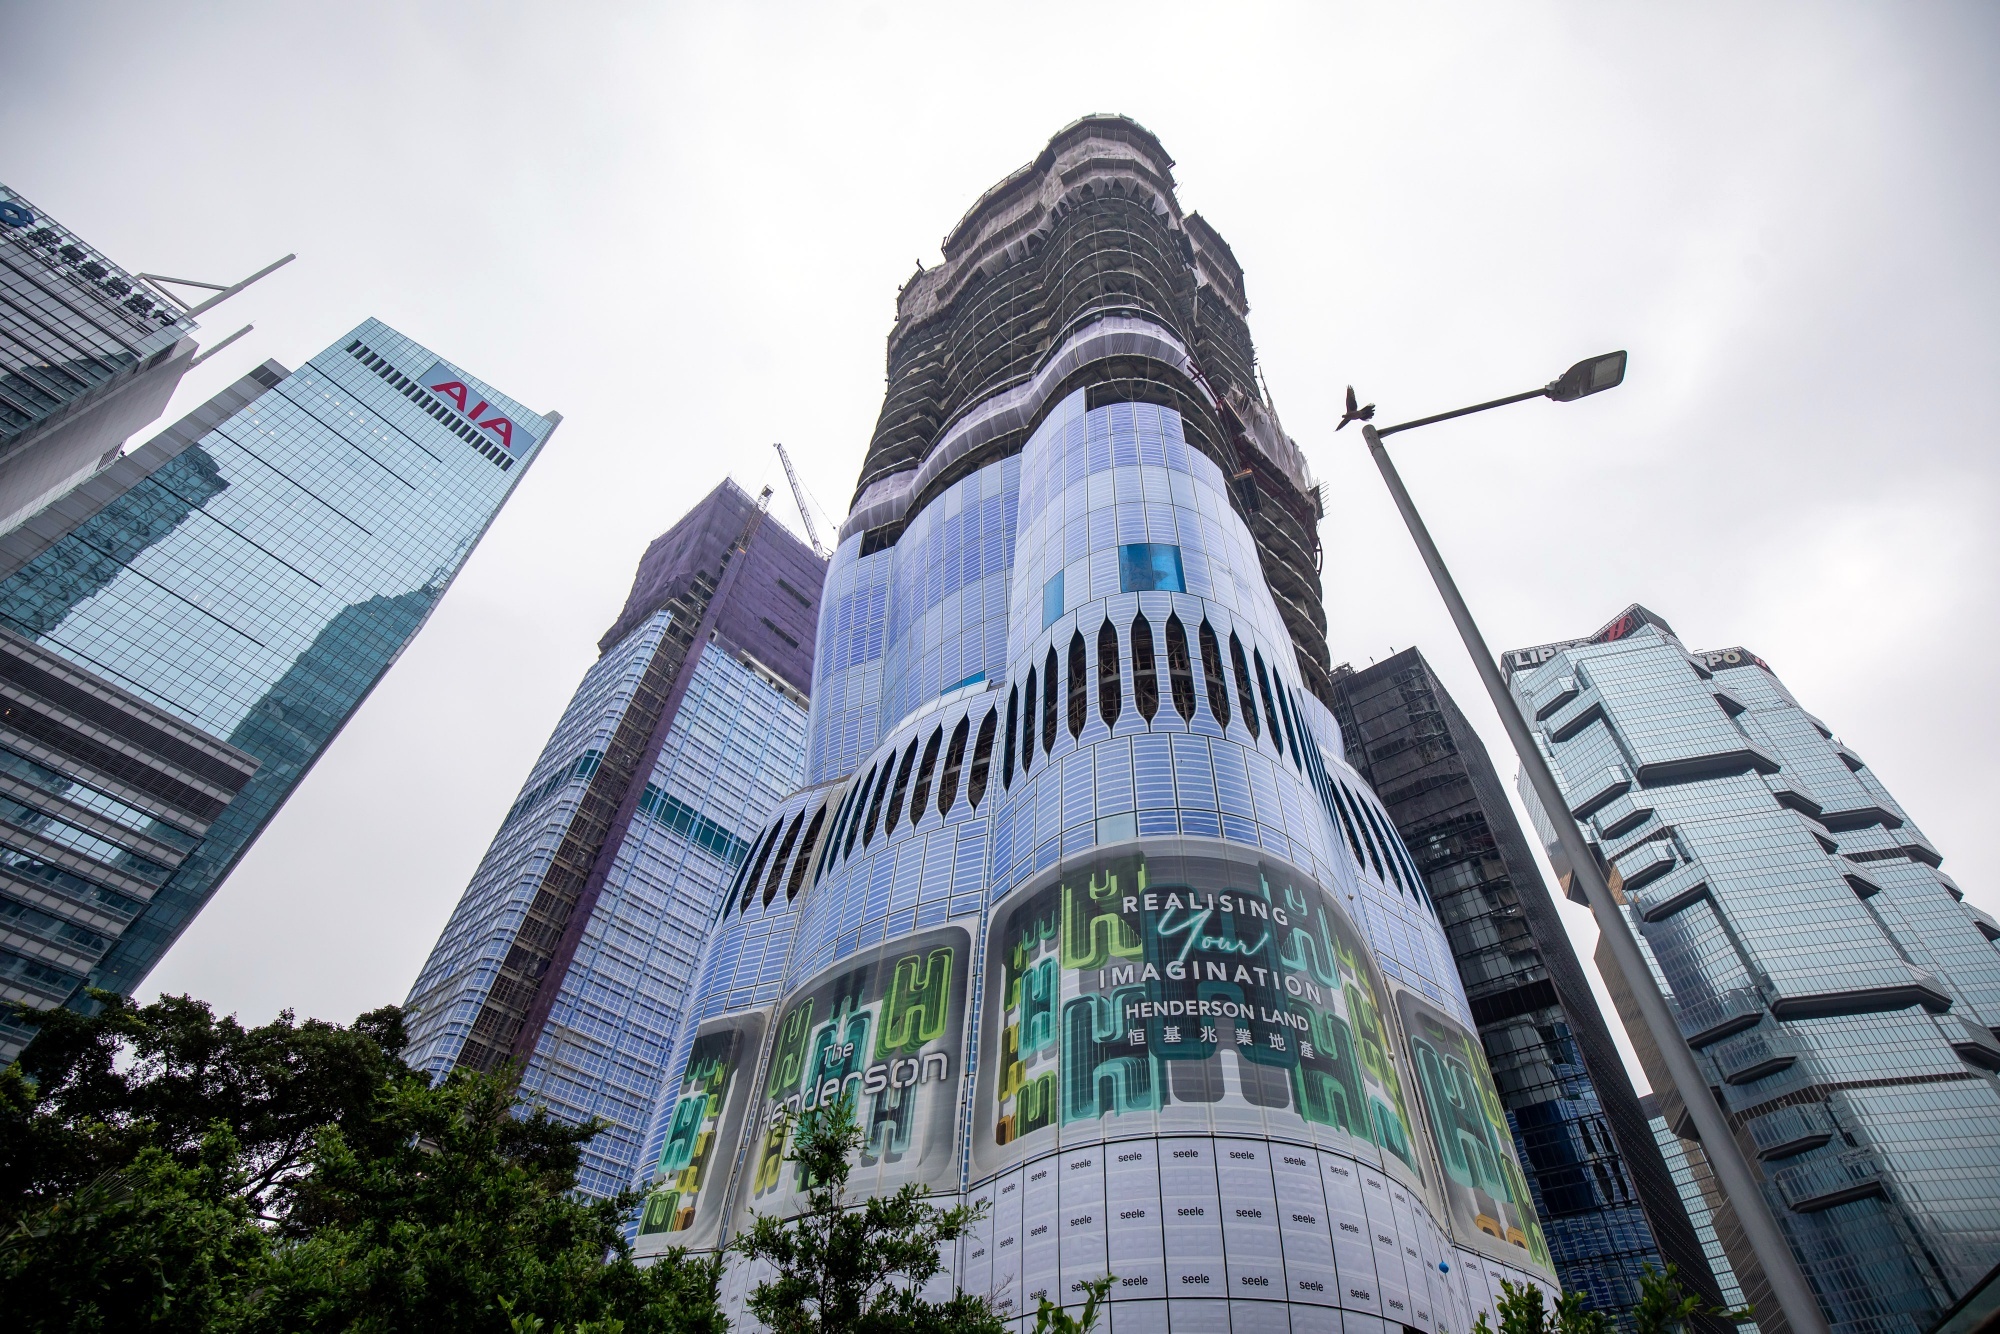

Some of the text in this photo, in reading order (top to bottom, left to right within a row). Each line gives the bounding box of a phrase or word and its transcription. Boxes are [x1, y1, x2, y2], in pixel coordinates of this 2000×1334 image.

[430, 381, 512, 449] AIA
[1122, 892, 1289, 926] REALISING
[1157, 906, 1269, 972] Your
[1100, 960, 1322, 1005] IMAGINATION
[1126, 1000, 1310, 1032] HENDERSON LAND
[1127, 1025, 1316, 1060] 恒基兆業地產
[823, 1041, 854, 1066] The
[754, 1052, 948, 1142] Henderson
[1118, 1152, 1142, 1162] seele
[1173, 1149, 1198, 1158] seele
[1230, 1151, 1254, 1159] seele
[1071, 1159, 1091, 1170] seele
[1284, 1157, 1306, 1166] seele
[1031, 1170, 1046, 1182] seele
[1330, 1165, 1349, 1177] seele
[1002, 1183, 1015, 1194] seele
[1367, 1178, 1381, 1190] seele
[1121, 1209, 1145, 1219] seele
[1178, 1207, 1204, 1216] seele
[1236, 1209, 1261, 1218] seele
[1071, 1215, 1091, 1226] seele
[1293, 1215, 1315, 1224] seele
[1031, 1225, 1047, 1236] seele
[1340, 1223, 1358, 1233] seele
[1000, 1237, 1013, 1248] seele
[1378, 1235, 1392, 1246] seele
[972, 1248, 984, 1259] seele
[1122, 1276, 1148, 1286] seele
[1182, 1274, 1209, 1283] seele
[1242, 1276, 1268, 1286] seele
[1300, 1281, 1323, 1291] seele
[1351, 1289, 1369, 1300] seele
[1389, 1300, 1403, 1311] seele
[1417, 1310, 1428, 1321] seele
